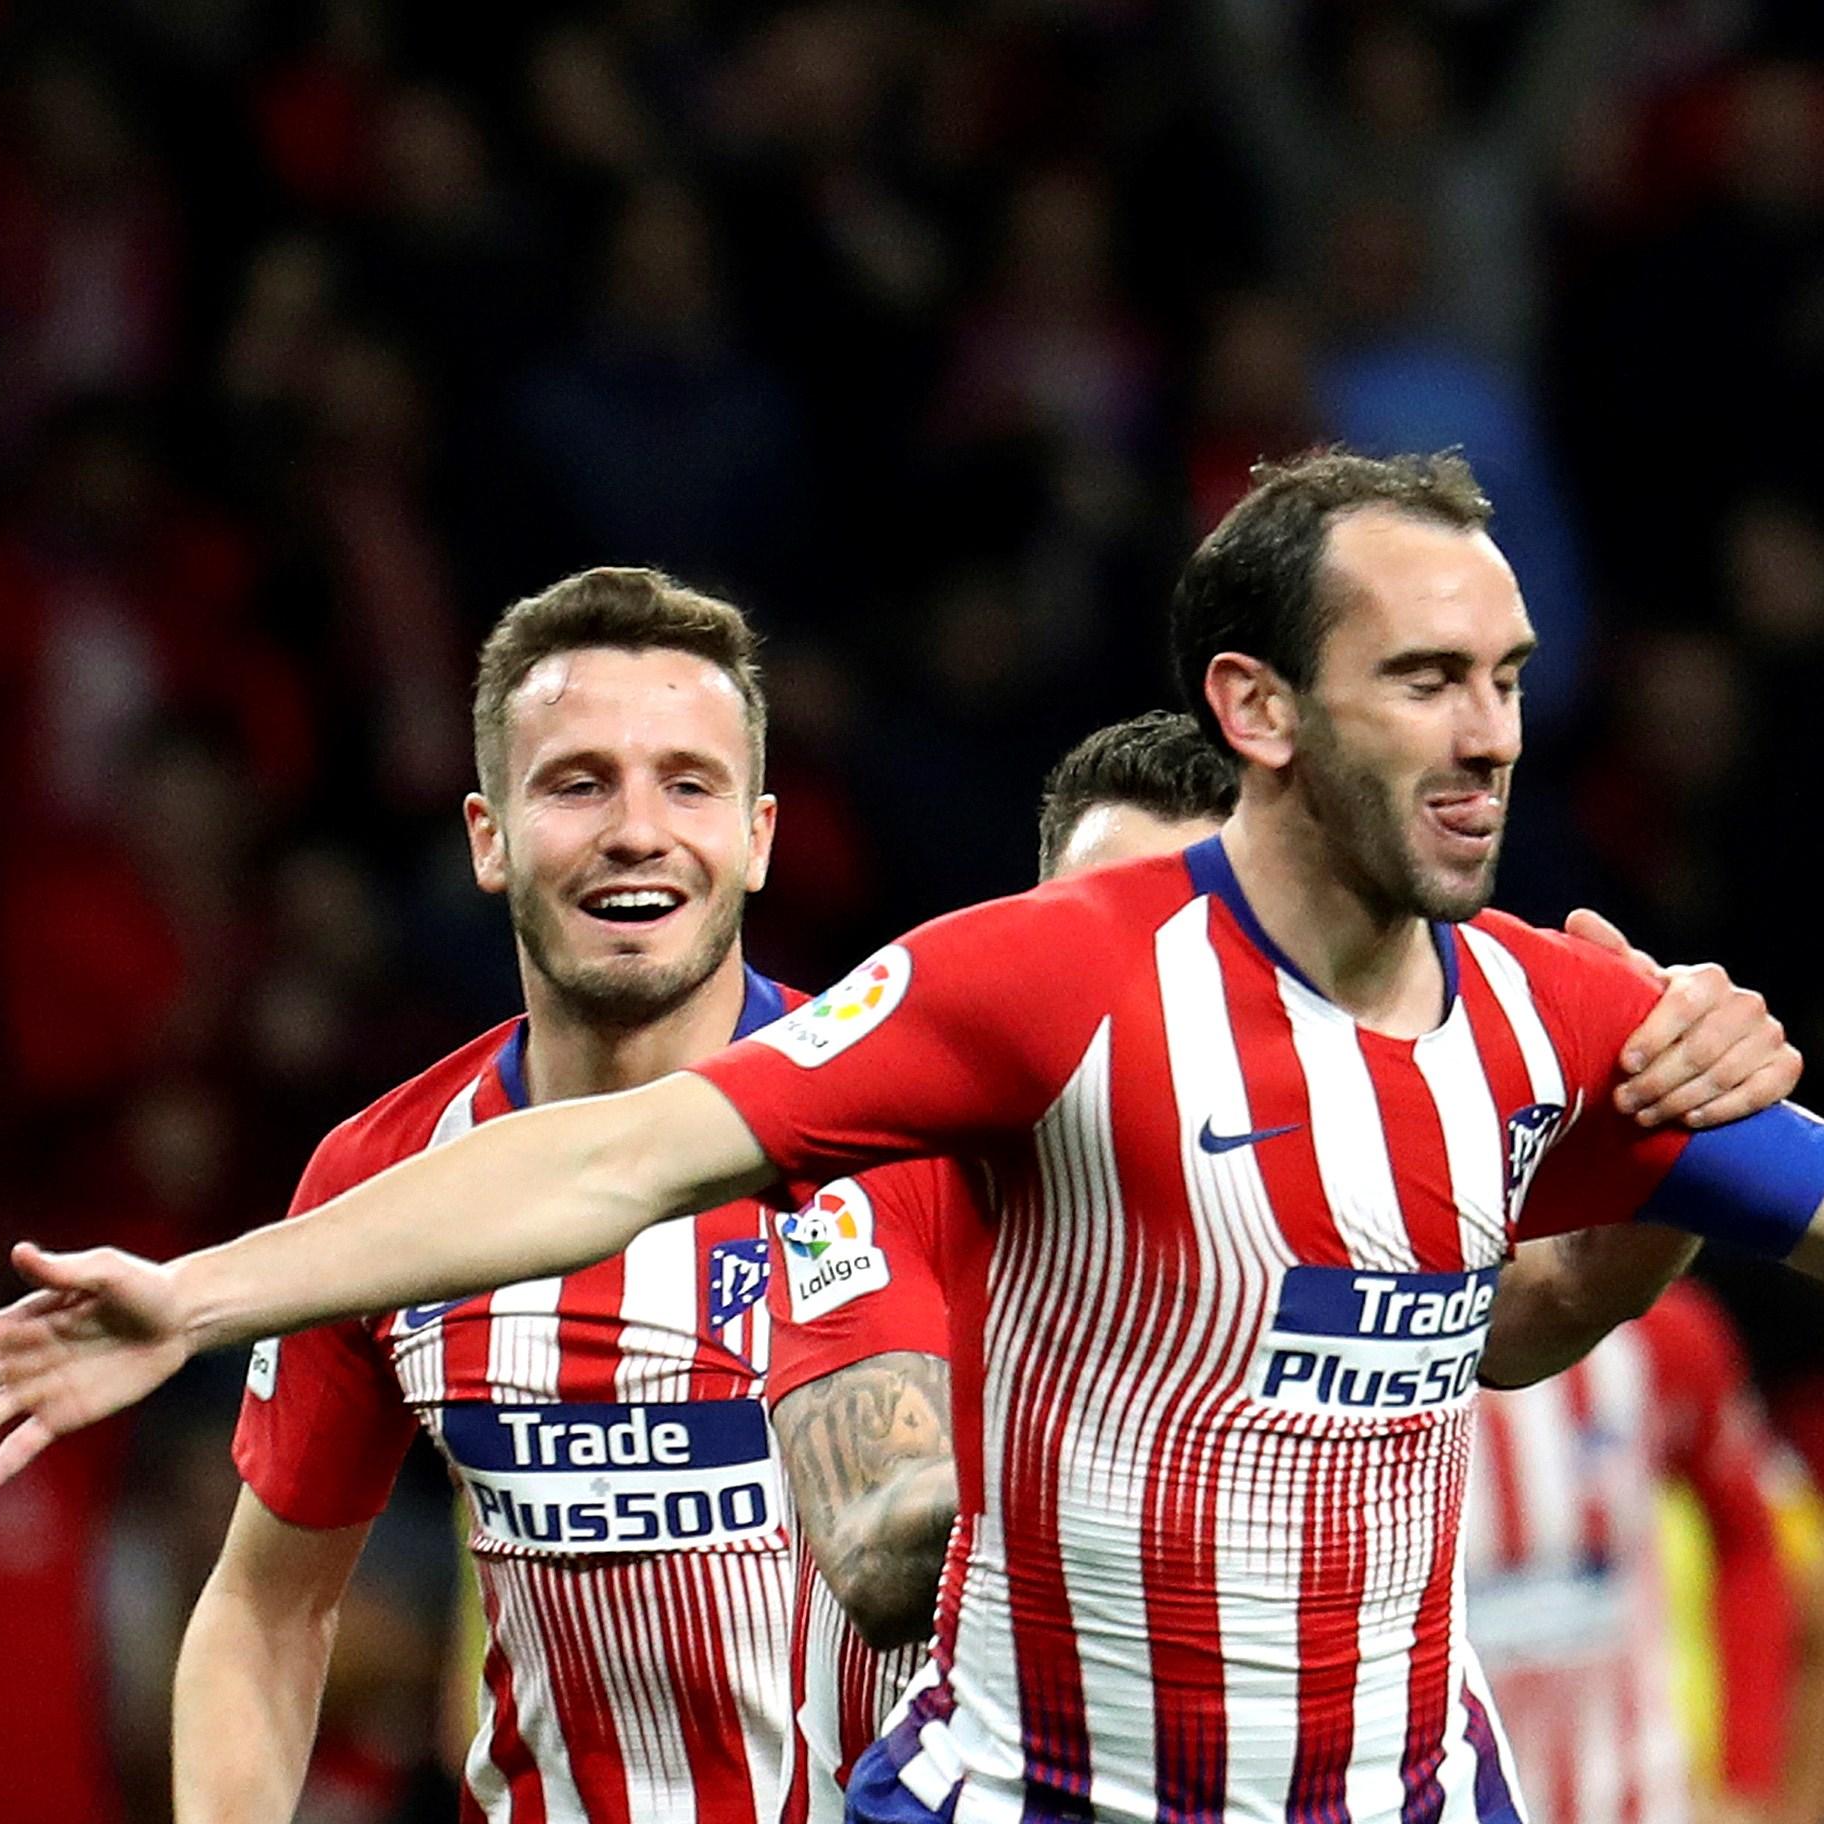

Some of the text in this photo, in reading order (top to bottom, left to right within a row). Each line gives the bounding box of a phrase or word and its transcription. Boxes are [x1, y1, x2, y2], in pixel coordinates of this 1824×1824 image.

[1352, 1274, 1495, 1335] Trade
[1260, 1349, 1479, 1408] Plus50
[498, 1407, 691, 1466] Trade
[471, 1481, 769, 1543] Plus500
